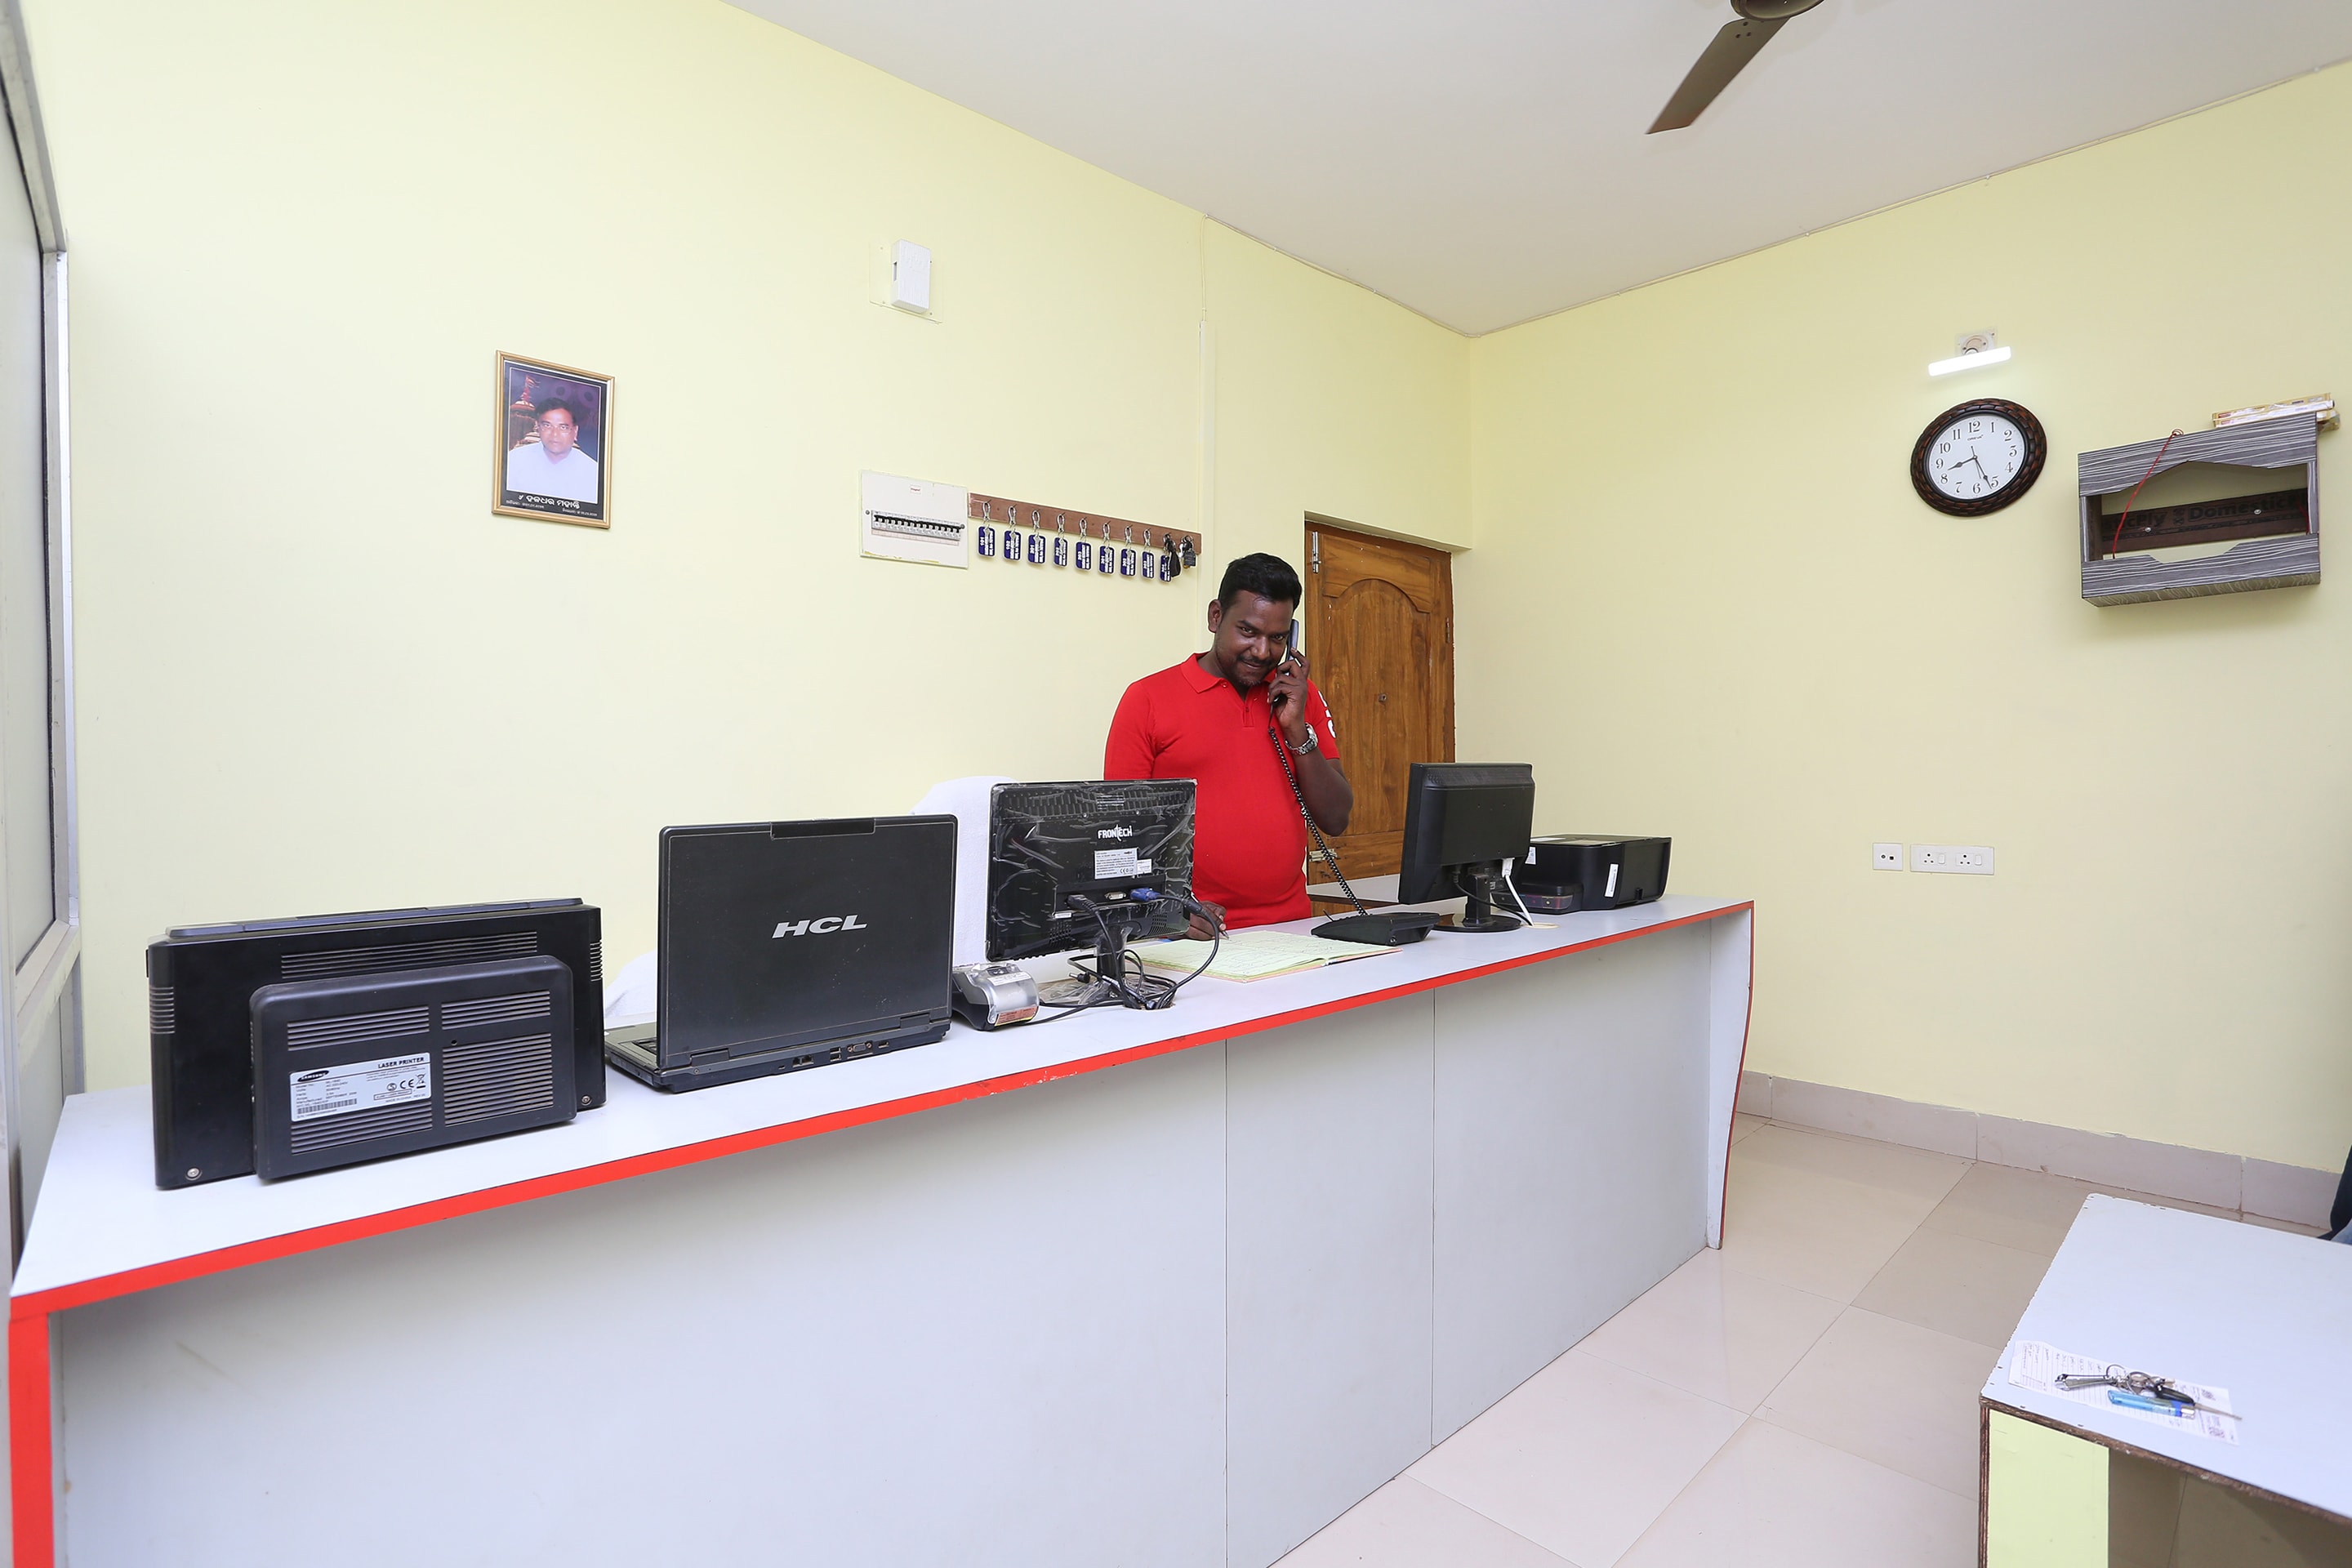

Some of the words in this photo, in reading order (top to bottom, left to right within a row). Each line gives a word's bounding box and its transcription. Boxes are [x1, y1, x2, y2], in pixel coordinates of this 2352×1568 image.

[1969, 421, 1980, 433] 12
[1990, 421, 1994, 433] 1
[1953, 429, 1961, 440] 11
[2004, 430, 2012, 442] 2
[1940, 442, 1951, 454] 10
[2009, 445, 2017, 457] 3
[1936, 458, 1944, 469] 9
[2005, 461, 2013, 473] 4
[1940, 474, 1949, 484] 8
[1991, 475, 1999, 488] 5
[1955, 481, 1962, 493] 7
[1972, 483, 1980, 493] 6
[1098, 824, 1133, 842] FRONTECH
[772, 915, 868, 939] HCL
[399, 1057, 425, 1065] PRINTER
